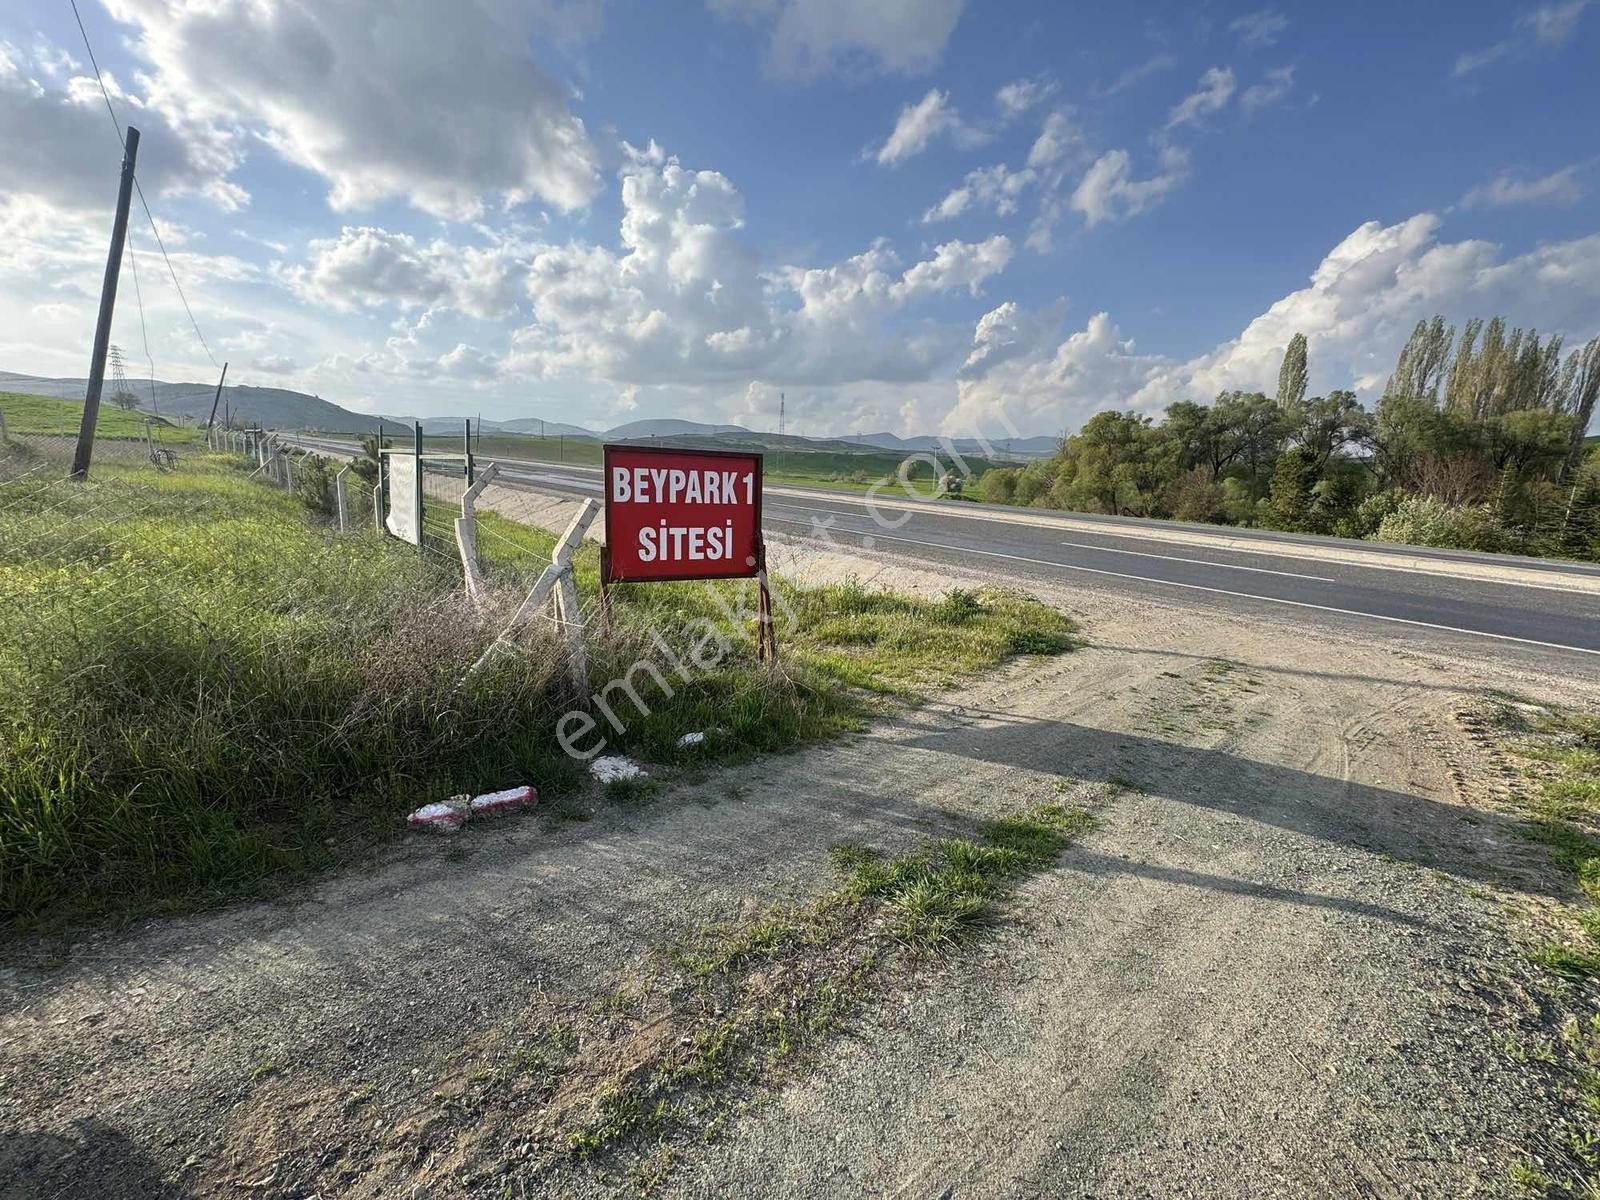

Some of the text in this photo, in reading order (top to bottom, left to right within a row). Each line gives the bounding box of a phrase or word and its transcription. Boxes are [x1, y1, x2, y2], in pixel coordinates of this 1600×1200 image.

[612, 466, 754, 505] BEYPARK 1
[638, 518, 733, 562] SİTESİ
